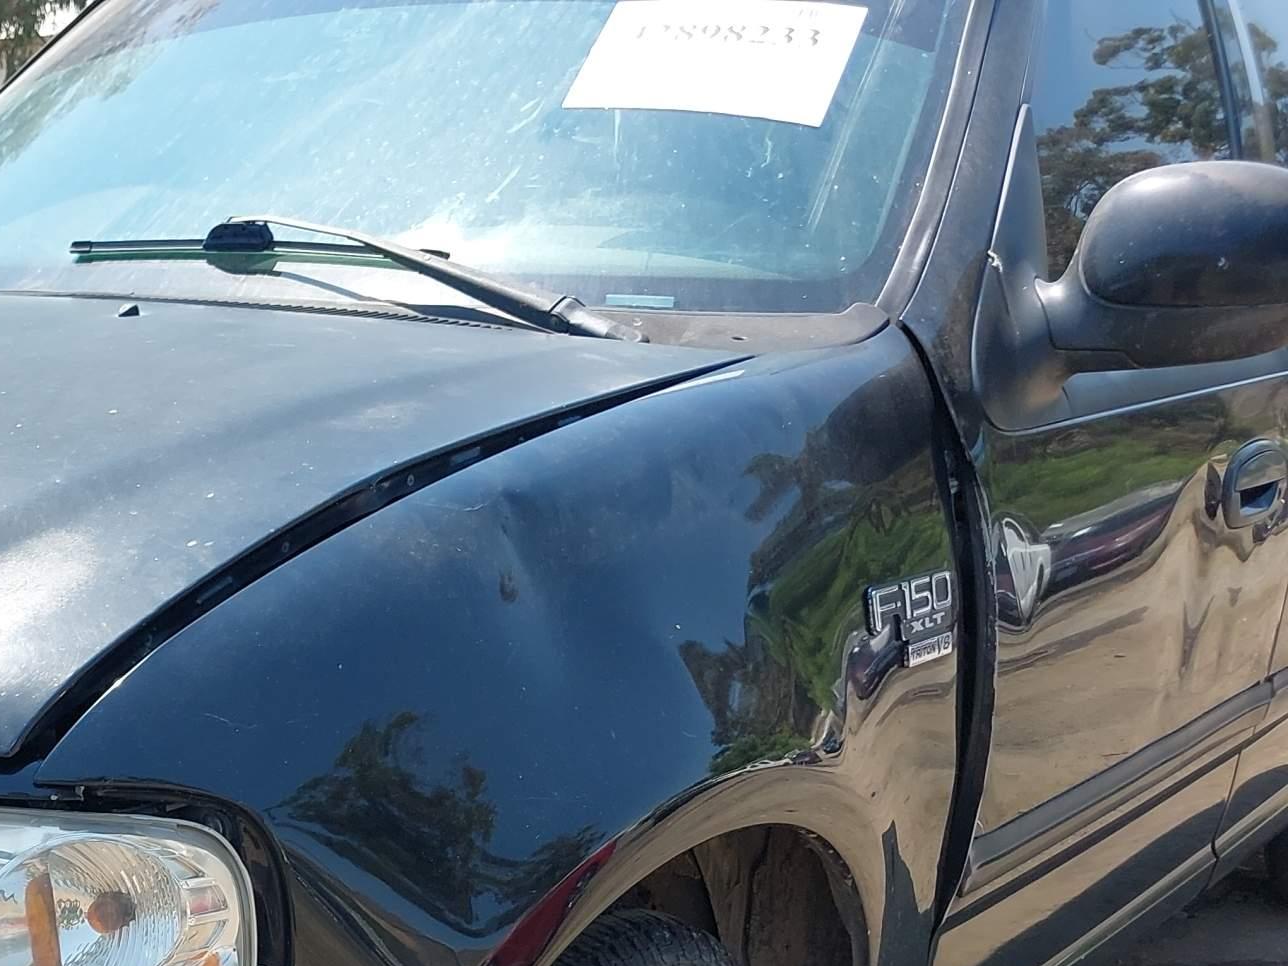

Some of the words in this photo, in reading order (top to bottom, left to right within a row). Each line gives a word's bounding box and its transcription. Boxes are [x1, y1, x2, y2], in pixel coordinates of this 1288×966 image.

[635, 24, 821, 47] 898233
[911, 612, 945, 633] XLT
[911, 643, 936, 659] TRITON
[936, 634, 951, 655] V8
